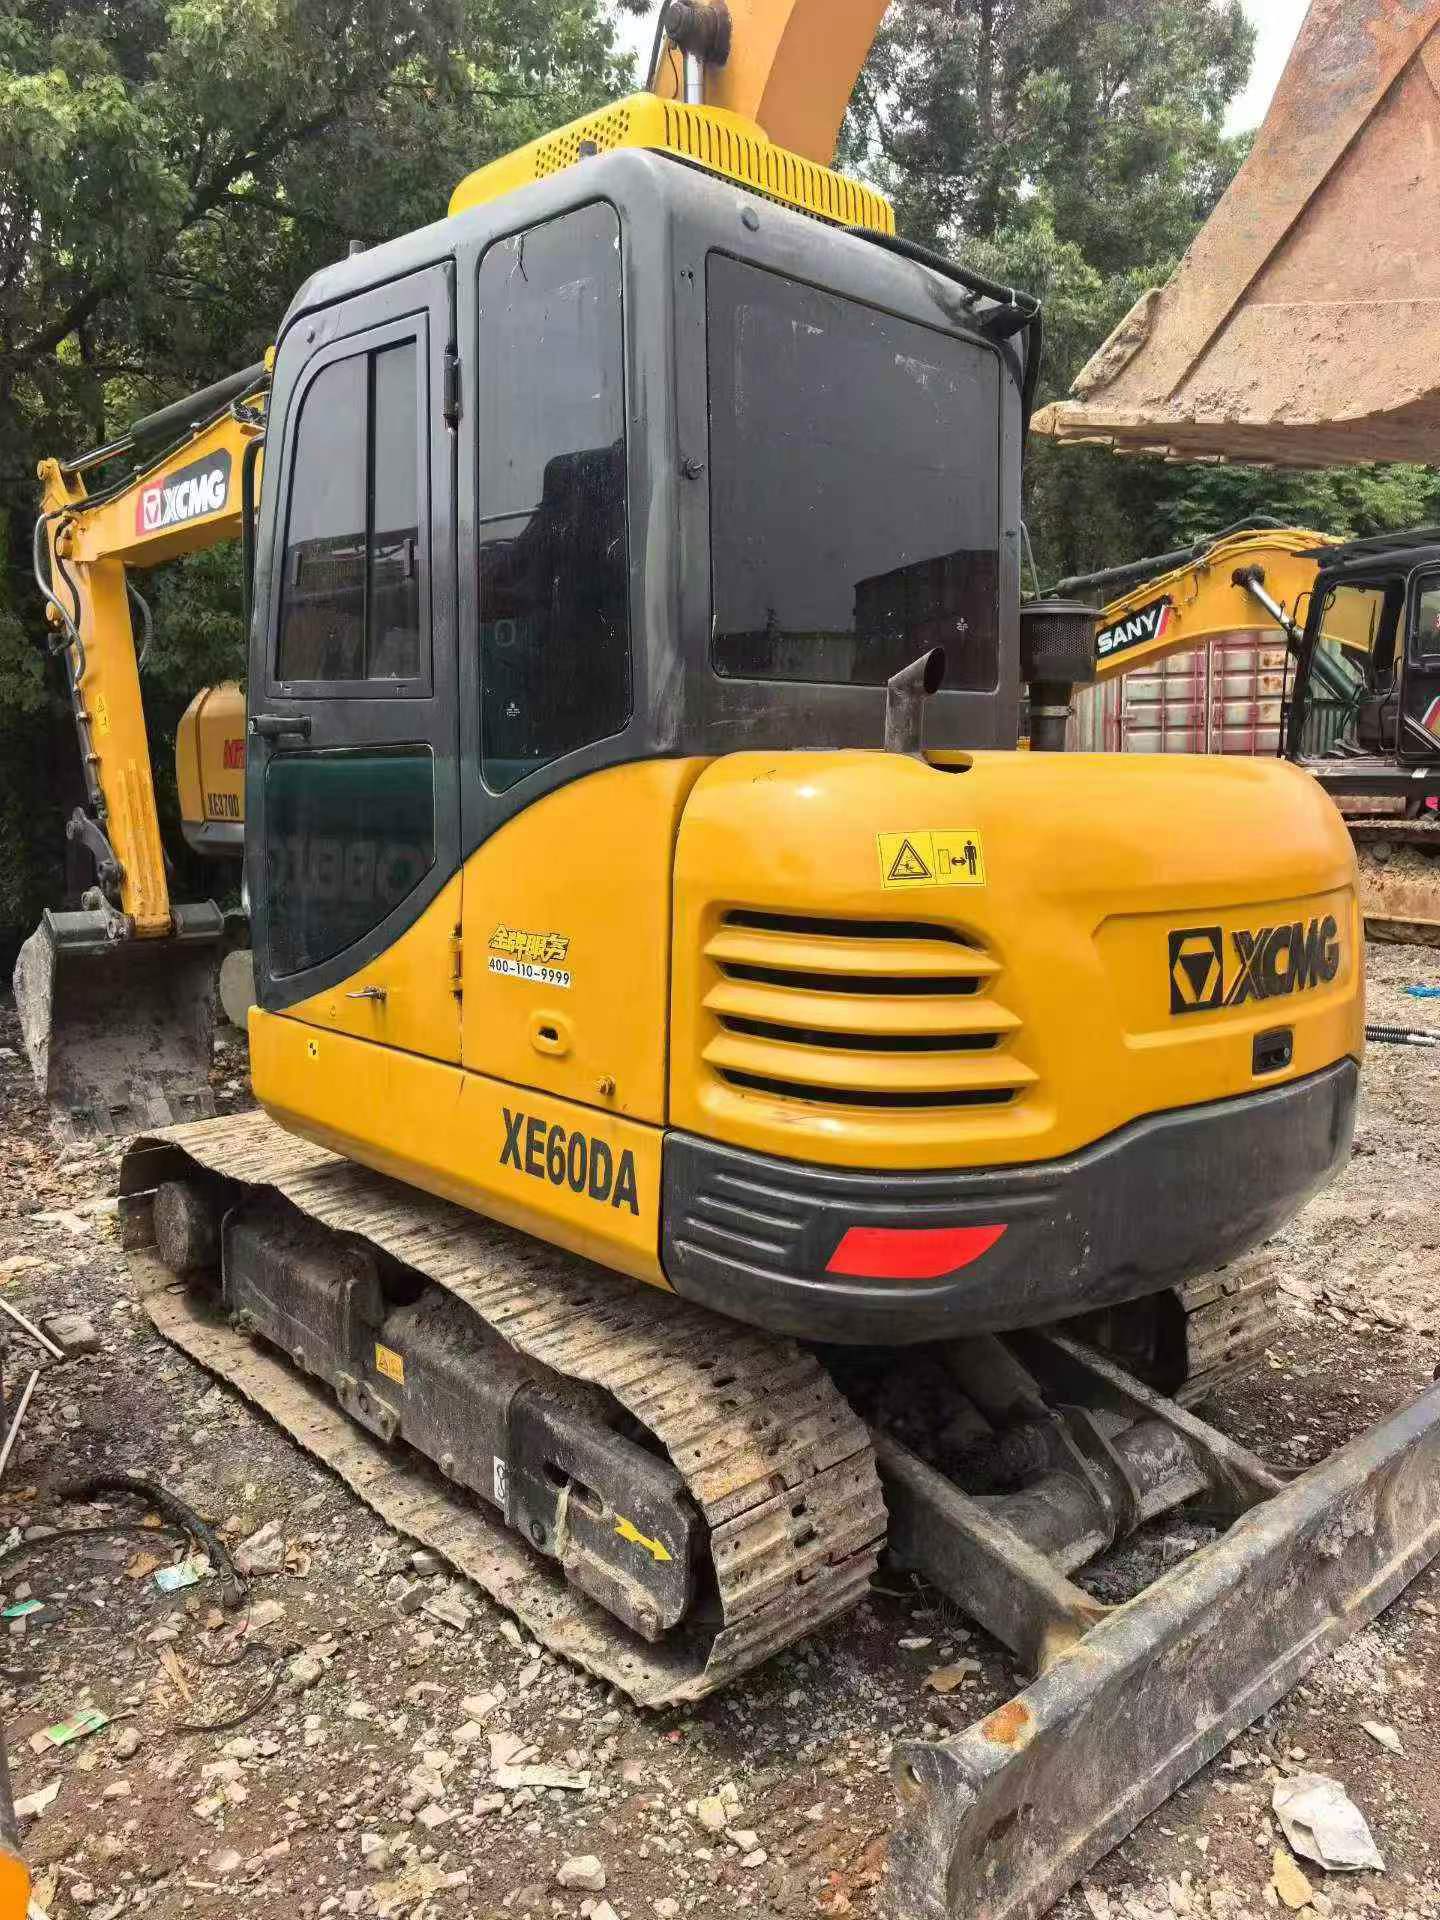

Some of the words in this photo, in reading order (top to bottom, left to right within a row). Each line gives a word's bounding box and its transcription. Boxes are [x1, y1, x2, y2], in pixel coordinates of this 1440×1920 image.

[162, 470, 226, 522] XCMG
[1098, 609, 1155, 654] SANY
[489, 957, 570, 985] 400-110-9999
[1223, 914, 1339, 1006] XCMG
[499, 1106, 640, 1216] XE60DA
